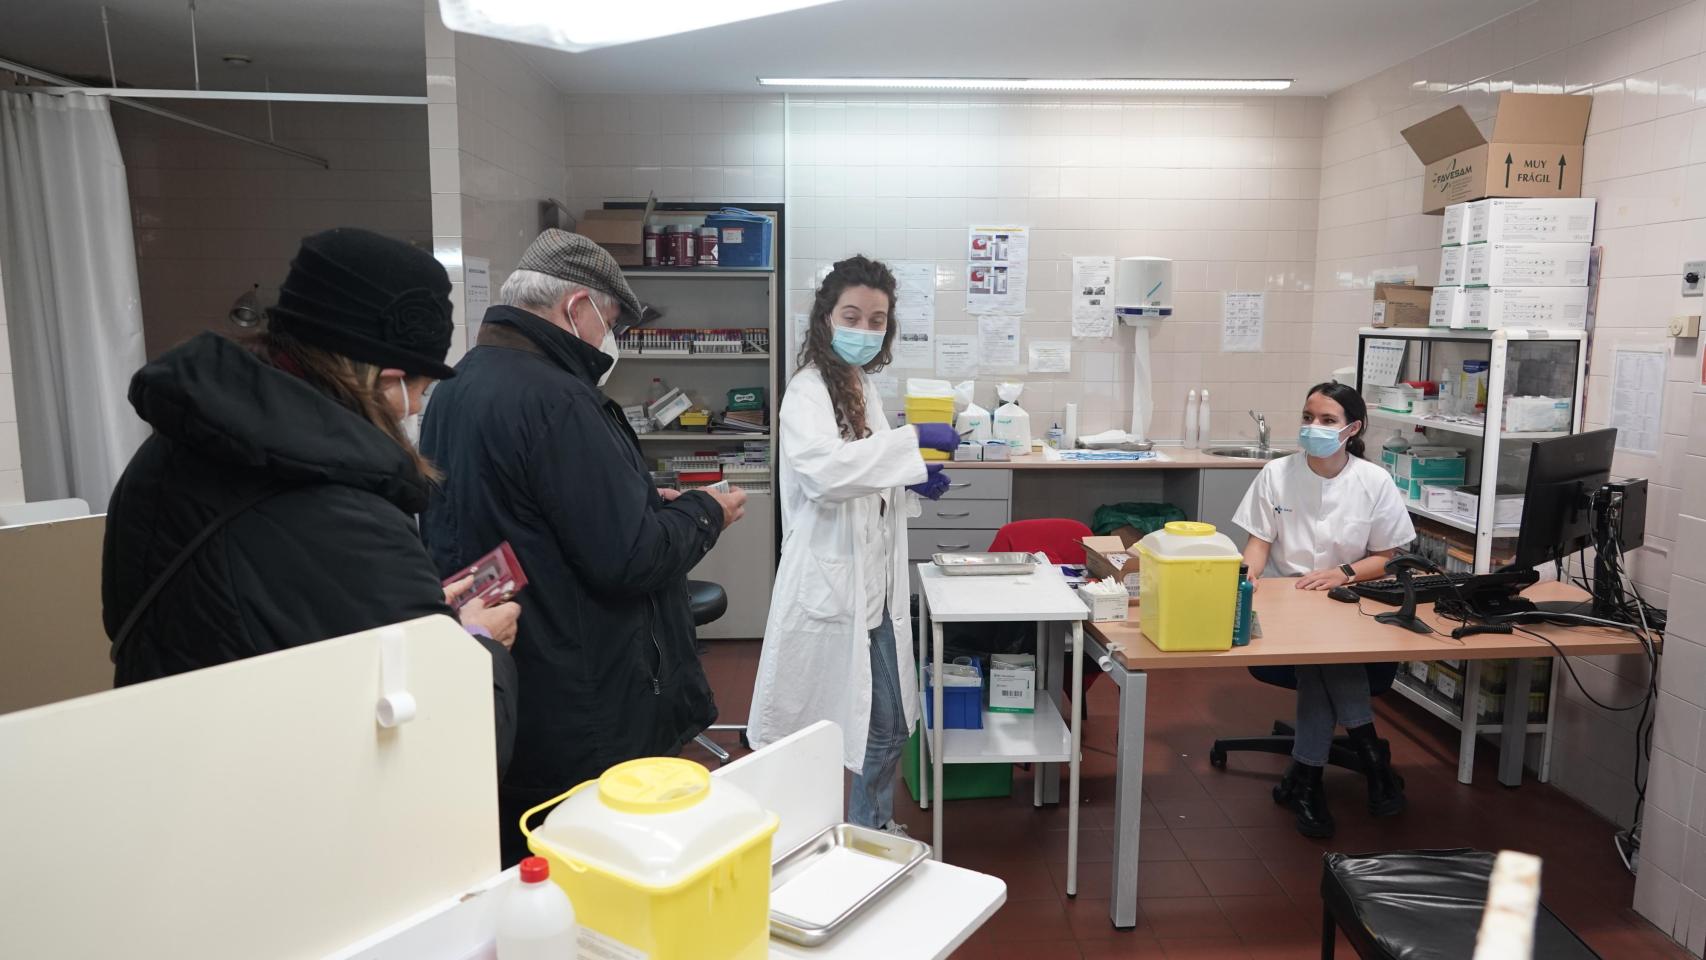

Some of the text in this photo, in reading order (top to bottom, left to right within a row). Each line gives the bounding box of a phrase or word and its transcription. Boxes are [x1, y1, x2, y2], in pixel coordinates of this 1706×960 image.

[1524, 160, 1547, 168] MUY
[1437, 165, 1472, 183] FAVESAM
[1517, 173, 1551, 183] FRÁGIL
